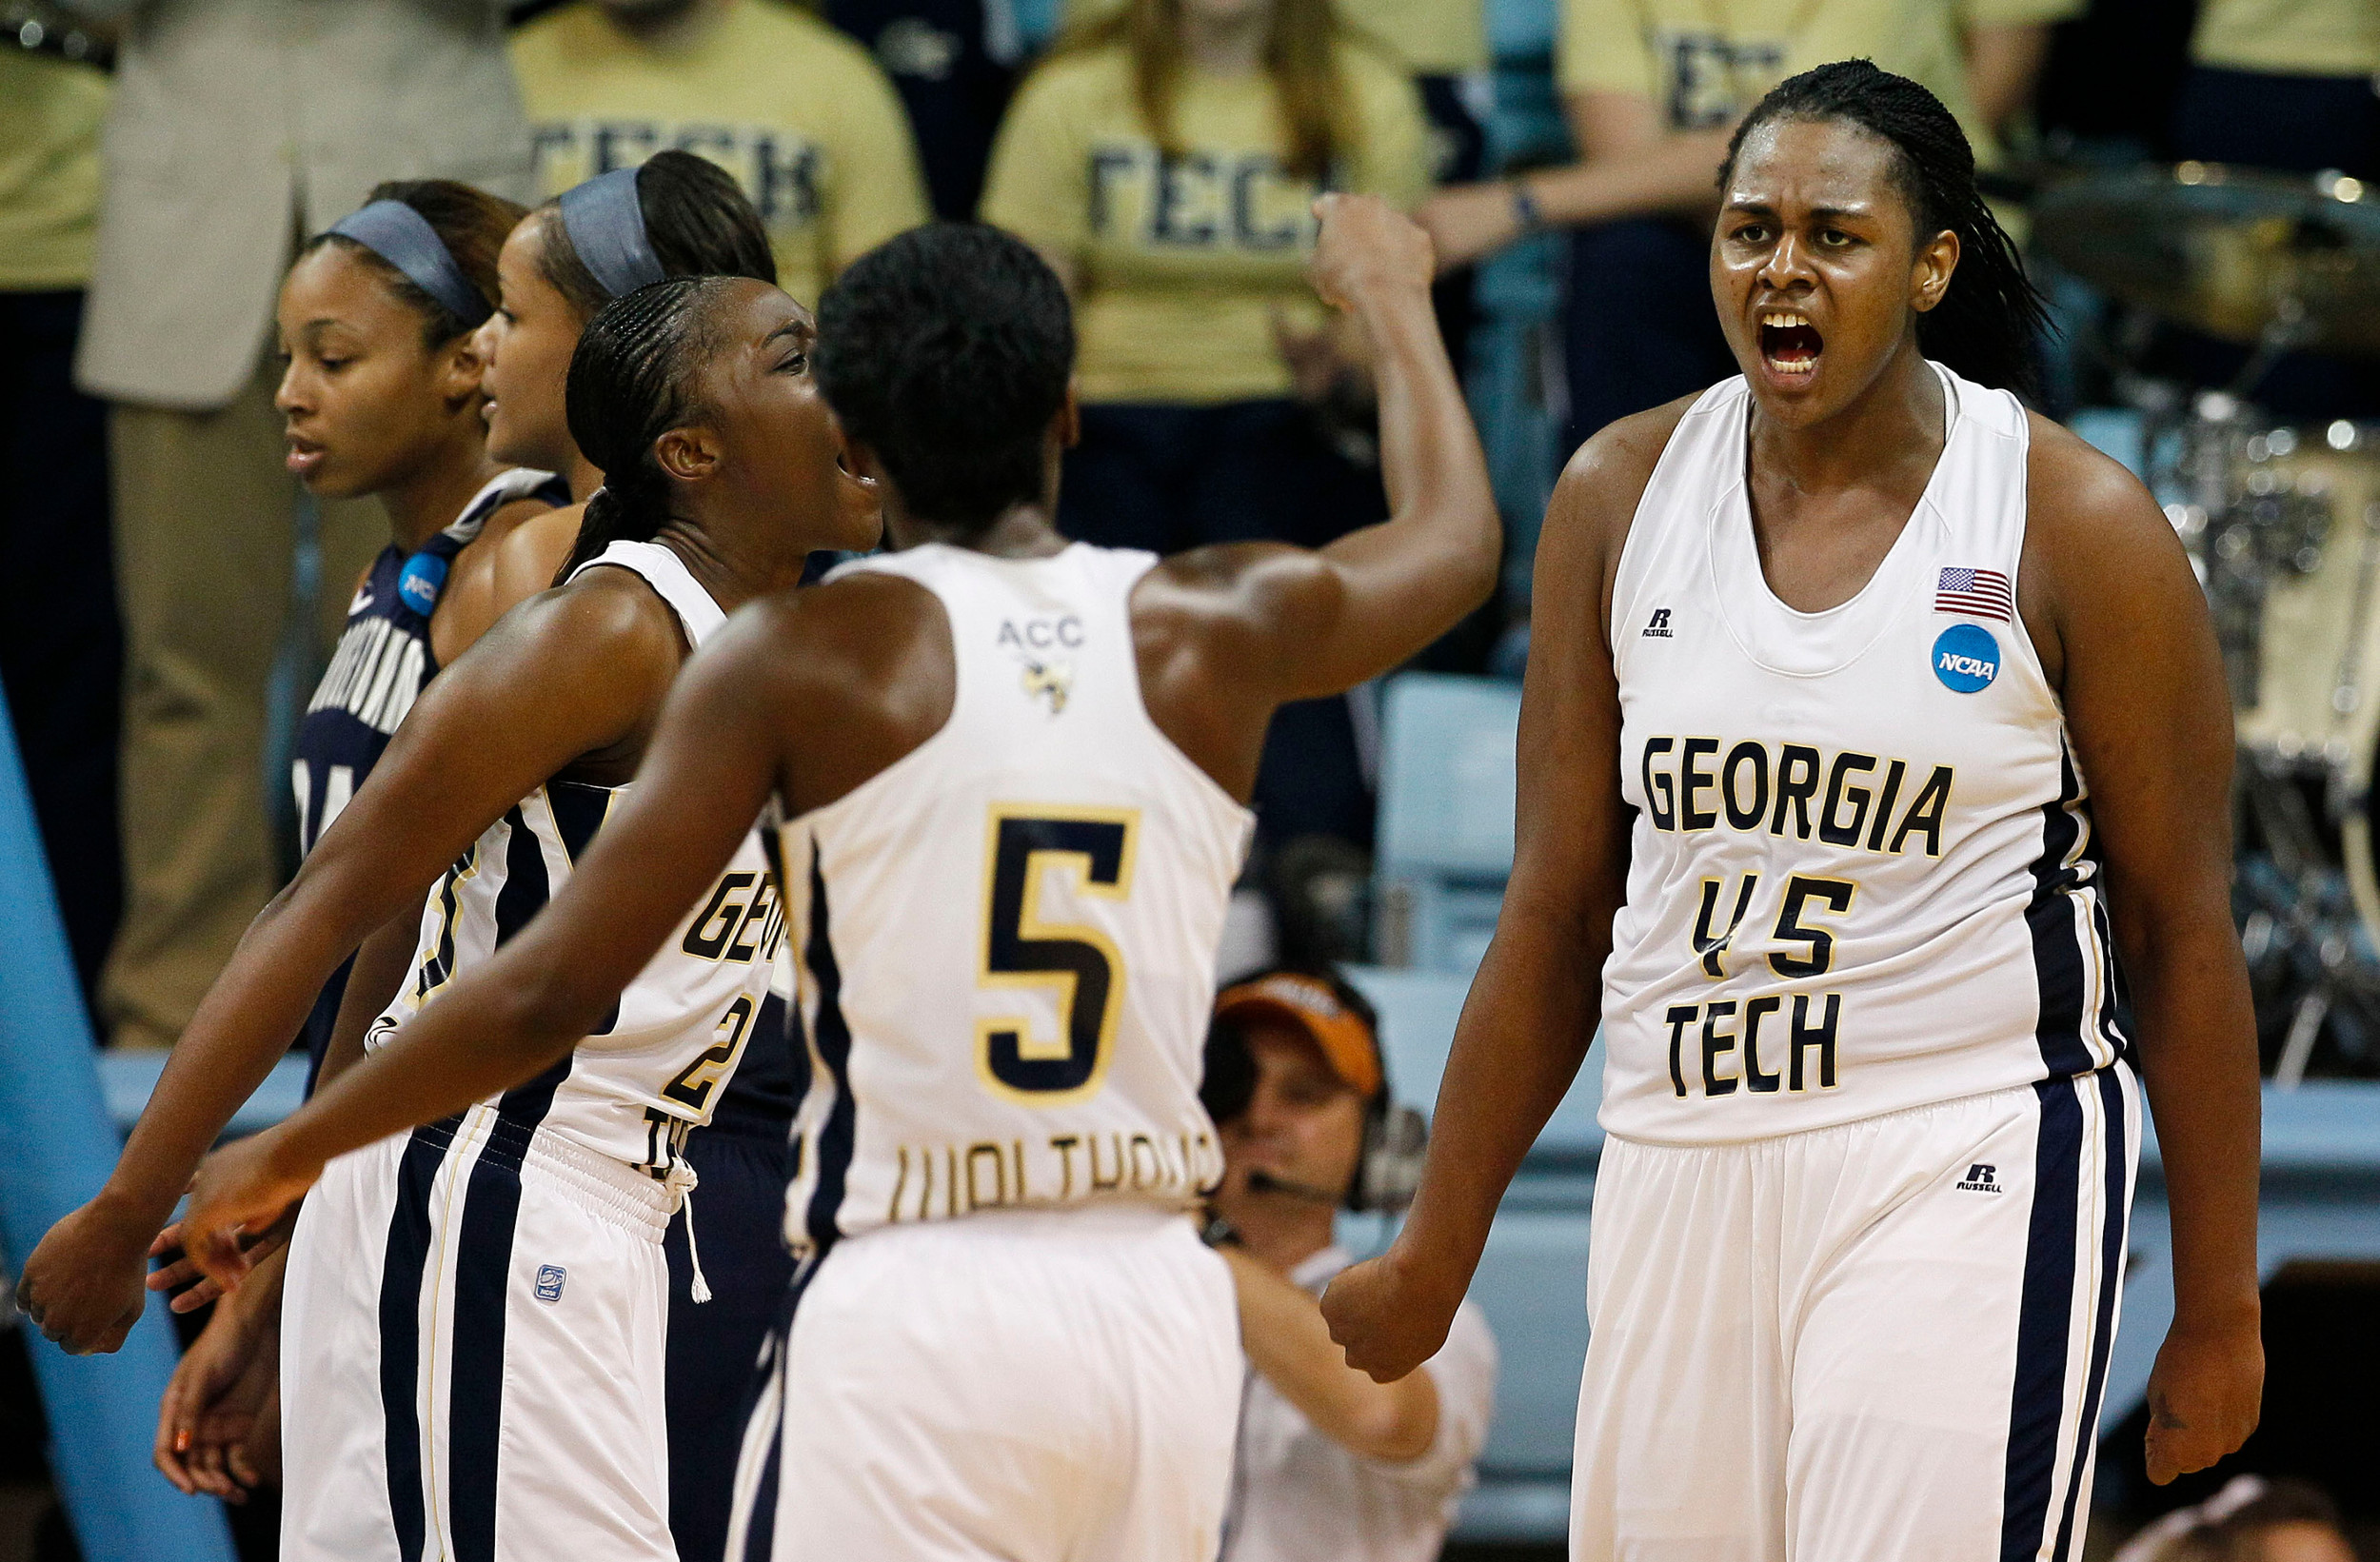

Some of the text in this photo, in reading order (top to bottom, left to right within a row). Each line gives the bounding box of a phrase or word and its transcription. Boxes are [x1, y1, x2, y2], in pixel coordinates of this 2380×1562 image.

[529, 124, 823, 215] TEH
[1087, 148, 1342, 249] TEC
[998, 617, 1085, 648] ACC
[1939, 652, 1994, 681] NCAA
[1642, 736, 1955, 858] GEORGIA
[973, 801, 1141, 1108] 5
[1692, 869, 1859, 980] 45
[1663, 992, 1842, 1099] TECH
[1956, 1181, 2002, 1194] RUSSELL
